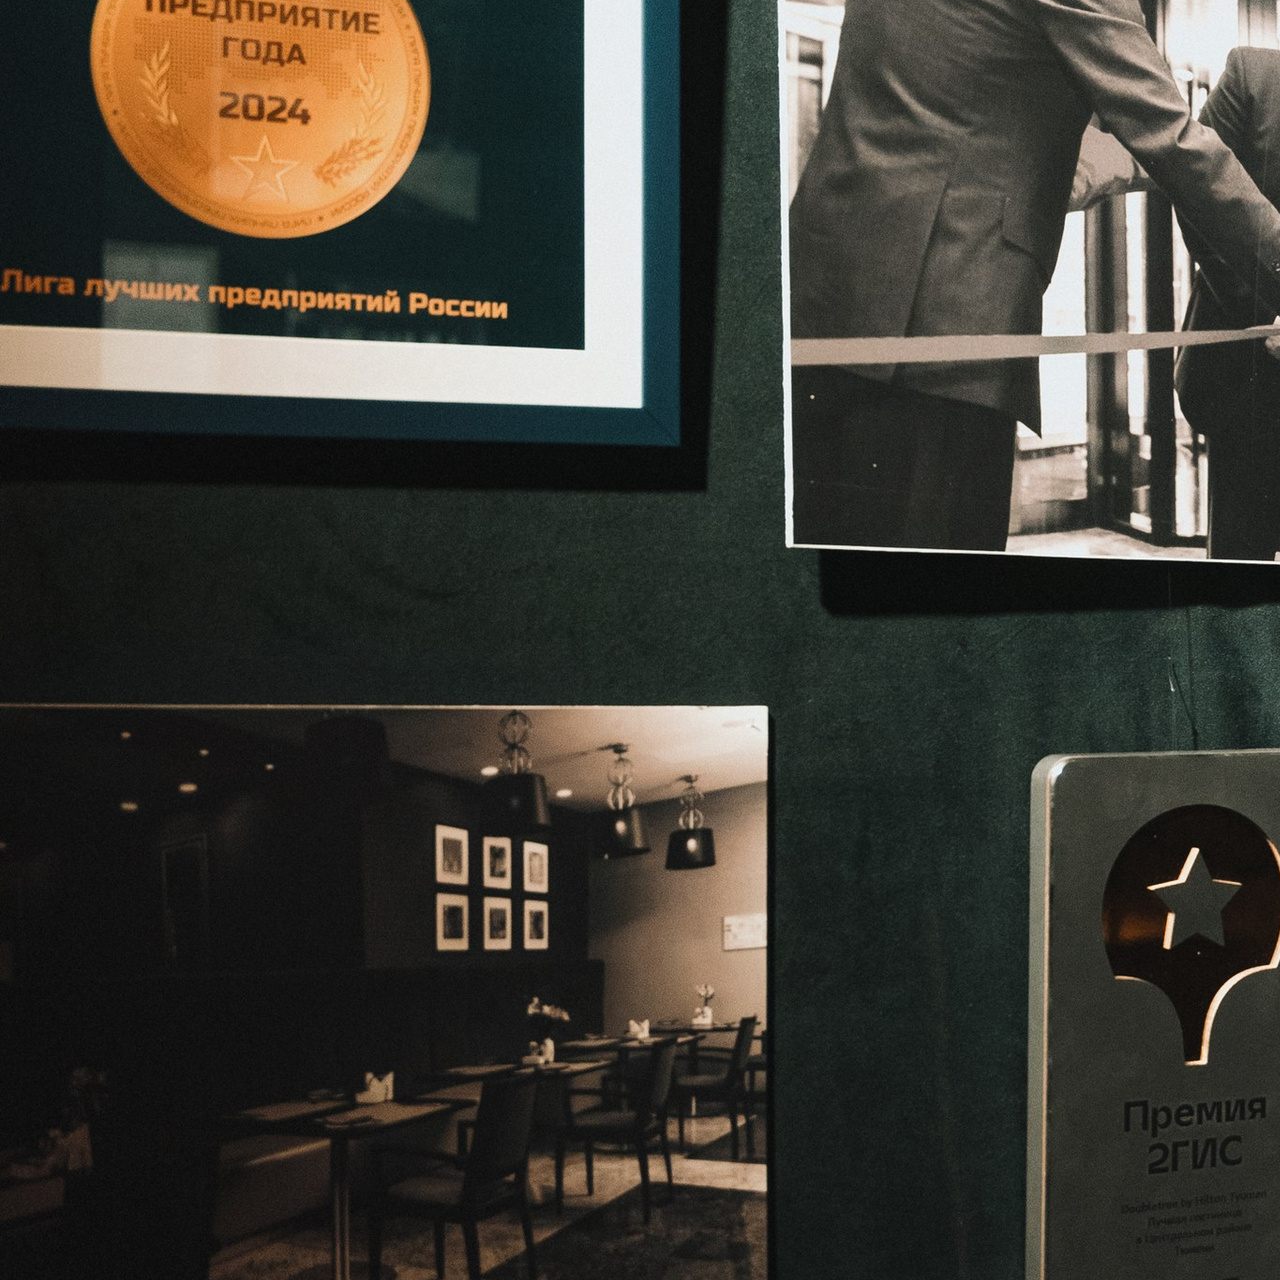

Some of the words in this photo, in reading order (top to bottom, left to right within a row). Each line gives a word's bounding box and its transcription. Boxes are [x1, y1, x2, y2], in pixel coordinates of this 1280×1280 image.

[222, 36, 306, 66] ГОДА
[219, 92, 310, 125] 2024
[2, 270, 75, 297] Лига
[84, 276, 199, 306] лучших
[209, 286, 402, 316] предприятий
[409, 291, 509, 320] России
[1124, 1096, 1266, 1138] Премия
[1148, 1135, 1242, 1174] 2ГИС
[1180, 1198, 1192, 1210] by
[1196, 1194, 1227, 1206] Hilton
